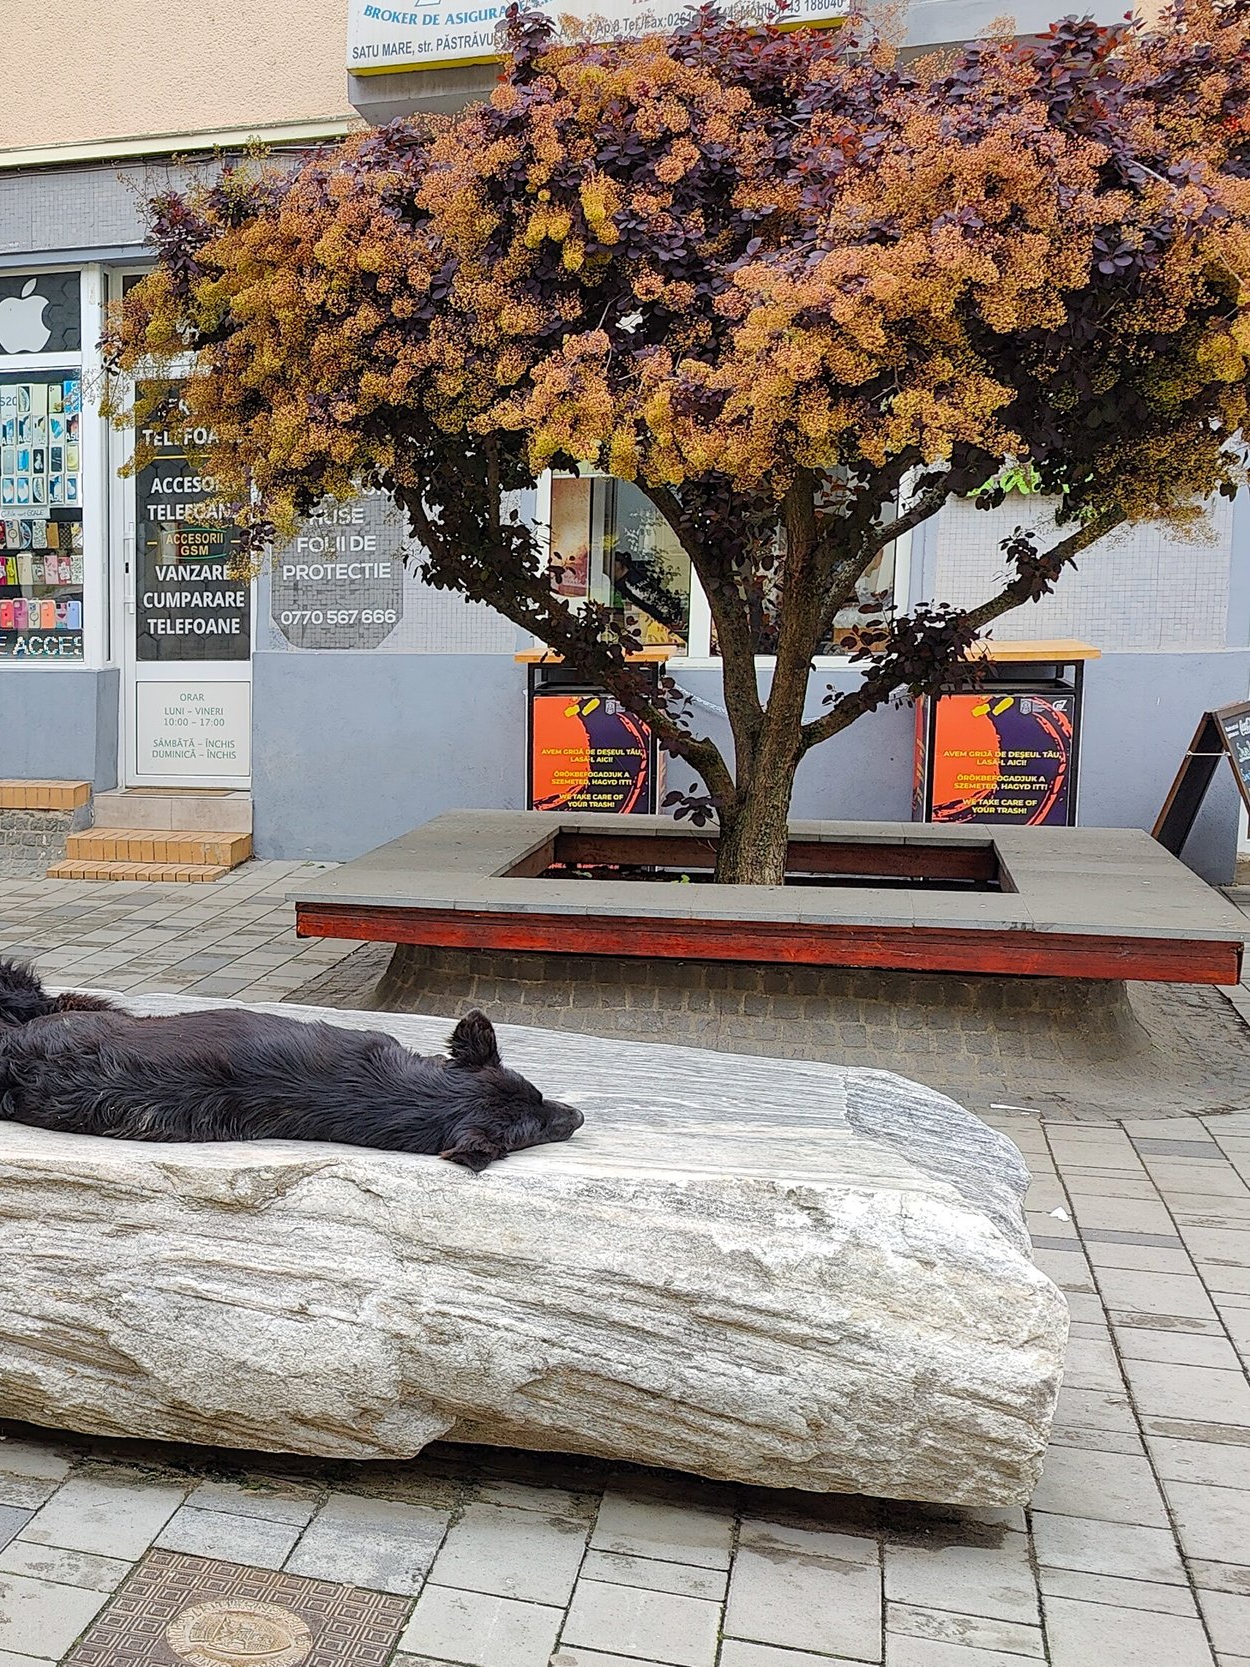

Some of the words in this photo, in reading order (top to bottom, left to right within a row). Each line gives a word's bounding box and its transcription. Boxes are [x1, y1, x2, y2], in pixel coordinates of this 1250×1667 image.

[363, 4, 417, 25] BROKER
[422, 15, 440, 25] DE
[444, 1, 526, 25] ASIGURAE
[352, 45, 379, 59] SATU
[382, 41, 415, 57] MARE,
[417, 40, 433, 53] str.
[147, 504, 238, 520] TELEFOAN
[166, 533, 224, 545] ACCESORII
[350, 535, 376, 551] DE
[180, 545, 209, 556] GSM
[282, 562, 391, 581] PROTECTIE
[143, 591, 245, 608] CUMPARARE
[281, 610, 323, 625] 0770
[326, 609, 359, 624] 567
[361, 609, 396, 624] 666
[147, 618, 240, 634] TELEFOANE
[179, 693, 205, 701] ORAR
[164, 707, 185, 715] LUNI
[195, 707, 224, 715] VINERI
[164, 718, 189, 726] 10:00
[200, 718, 225, 726] 17:00
[153, 738, 195, 747] SÂMBĂTĂ
[205, 738, 235, 748] ÎNCHIS
[152, 749, 197, 758] DUMINICĂ
[206, 749, 237, 759] ÎNCHIS
[943, 750, 967, 758] AVEM
[995, 750, 1006, 758] DE
[592, 778, 617, 786] HAGYD
[971, 806, 996, 814] YOUR
[997, 806, 1027, 814] TRASH!
